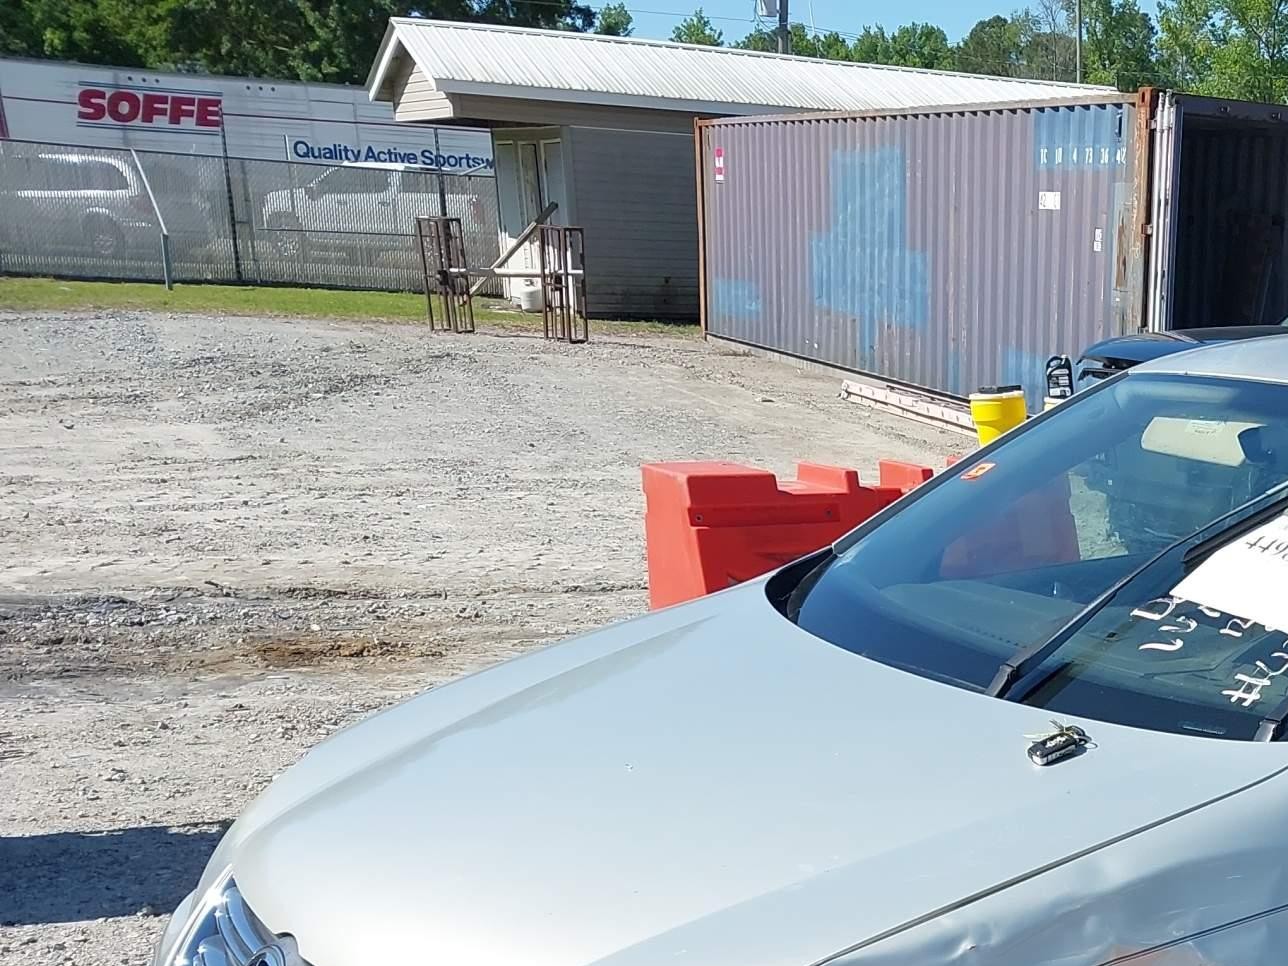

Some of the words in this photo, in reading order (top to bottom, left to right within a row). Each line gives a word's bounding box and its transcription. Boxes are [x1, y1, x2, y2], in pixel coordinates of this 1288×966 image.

[78, 89, 221, 127] SOFFE
[294, 141, 361, 162] Quality
[364, 145, 418, 165] Active
